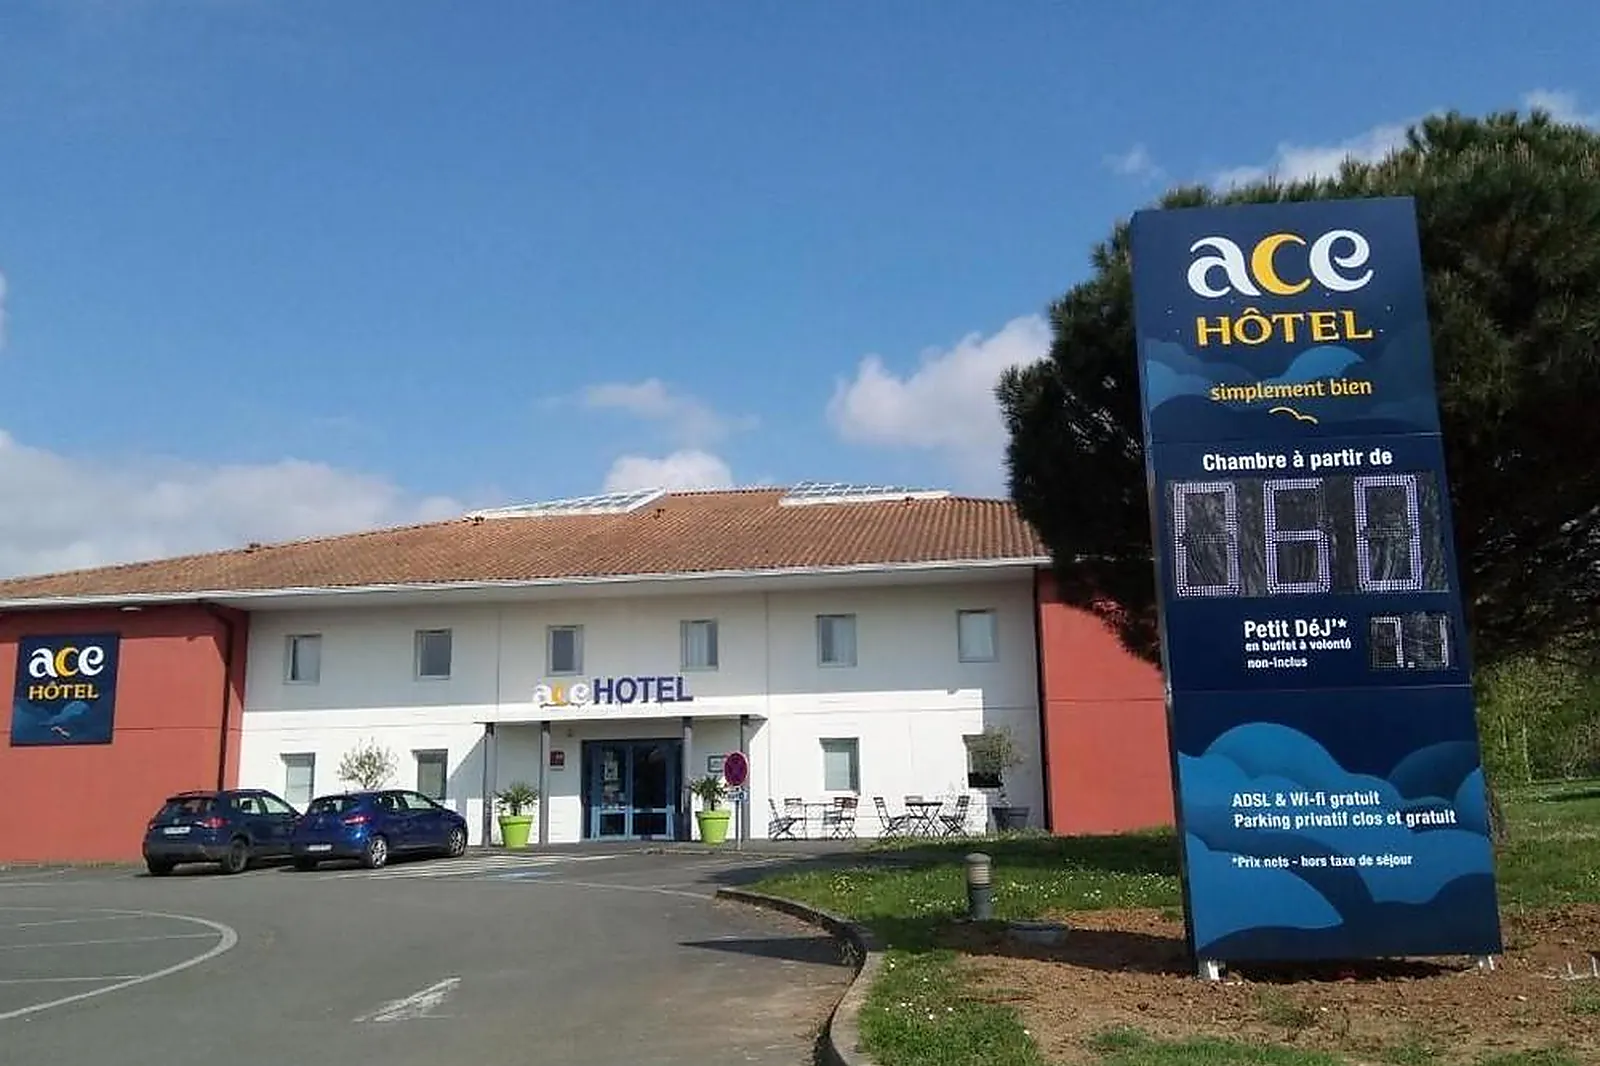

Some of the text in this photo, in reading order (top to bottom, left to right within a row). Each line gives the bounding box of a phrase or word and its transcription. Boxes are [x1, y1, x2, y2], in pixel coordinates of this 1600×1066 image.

[1187, 229, 1374, 298] ace
[1195, 306, 1374, 345] HÔTEL
[1210, 378, 1372, 403] simplement bien
[1202, 447, 1393, 471] Chambre à partir de
[1244, 619, 1290, 638] Petit
[1245, 637, 1352, 651] en buffet à volonté
[29, 646, 104, 678] ace
[1247, 656, 1308, 668] non-inclus
[28, 681, 100, 700] HÔTEL
[592, 676, 694, 705] HOTEL
[1232, 790, 1380, 808] ADSL & Wi-fi gratuit
[1234, 809, 1457, 830] Parking privatif clos et gratuit
[1301, 855, 1327, 867] hors
[1330, 854, 1355, 867] taxe
[1358, 854, 1374, 866] de
[1376, 853, 1412, 868] séjour
